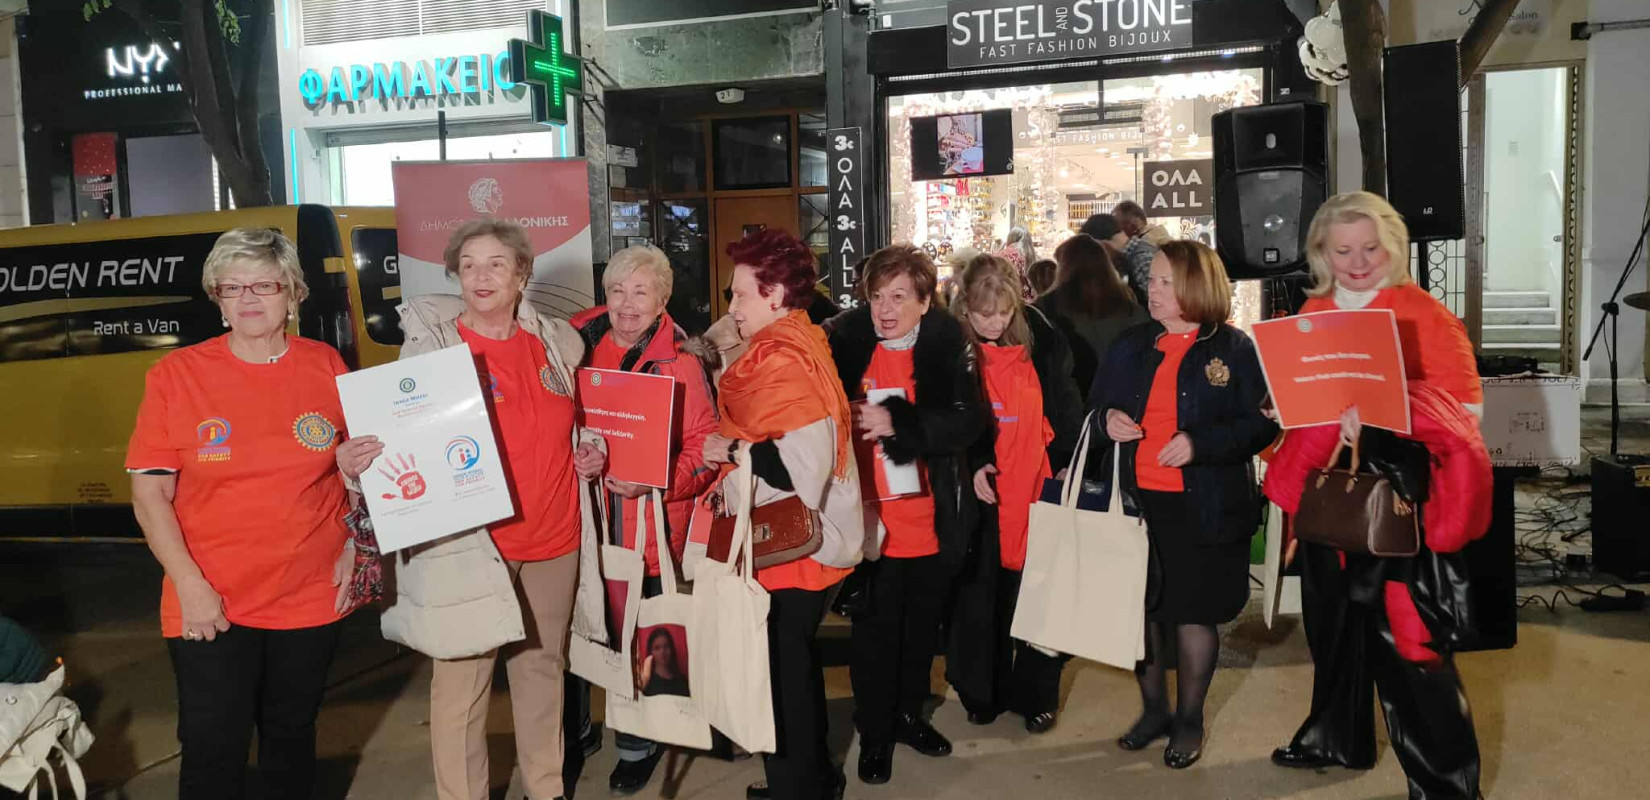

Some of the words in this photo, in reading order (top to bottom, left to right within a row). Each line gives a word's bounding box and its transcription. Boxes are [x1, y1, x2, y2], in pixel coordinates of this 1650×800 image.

[952, 4, 1056, 46] STEEL
[1055, 6, 1068, 30] AND
[1073, 0, 1192, 34] STONE
[980, 44, 1017, 59] FAST
[1028, 37, 1097, 55] FASHION
[1109, 30, 1171, 47] BIJOUX
[84, 84, 162, 99] PROFESSIONAL
[837, 157, 853, 209] ΟΛΑ
[1151, 169, 1203, 187] ΟΛΑ
[1151, 190, 1203, 209] ALL
[97, 256, 184, 287] RENT
[840, 237, 854, 288] ALL
[94, 321, 129, 336] Rent
[134, 322, 143, 334] a
[148, 319, 180, 333] Van
